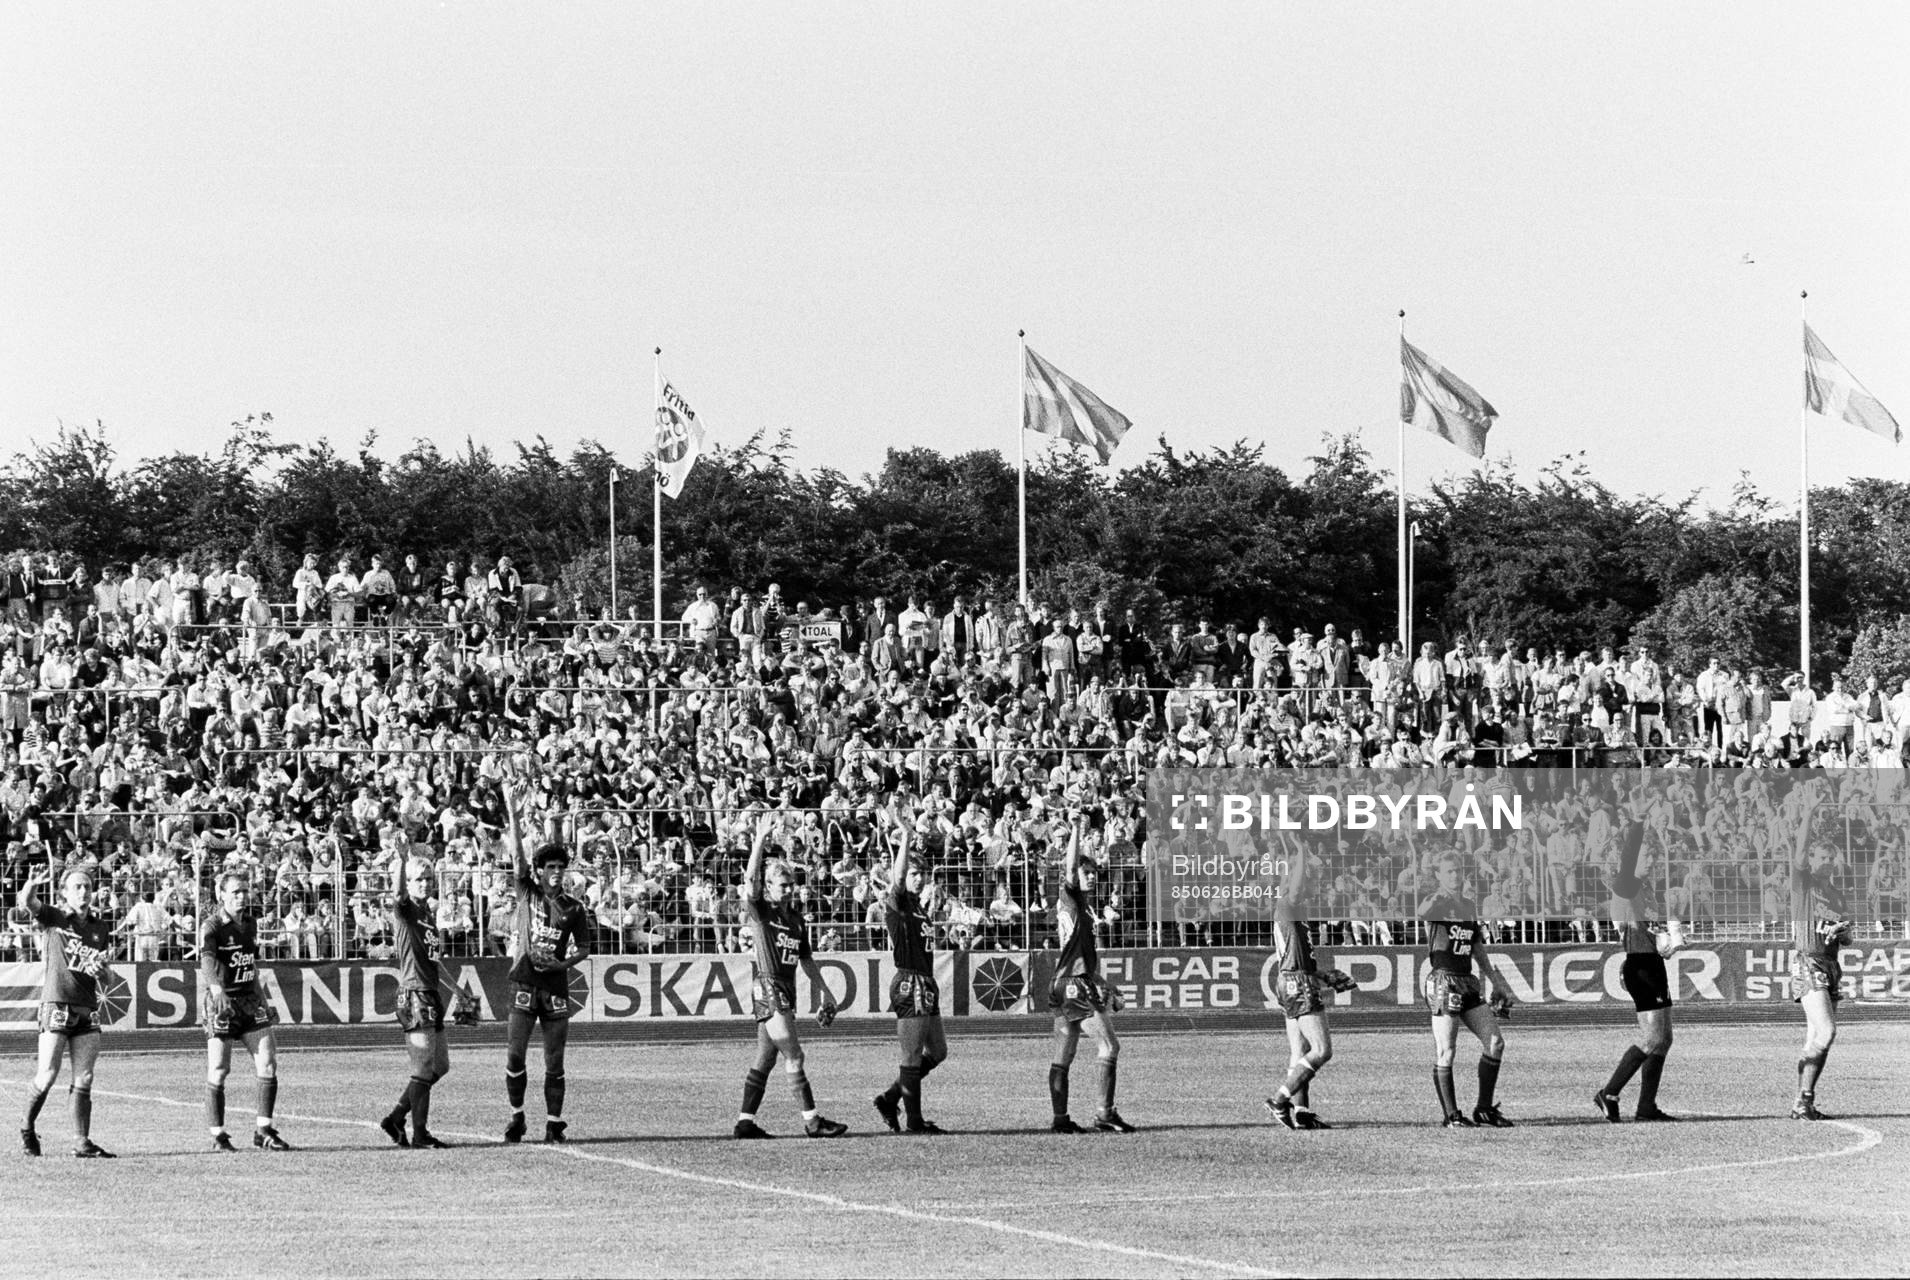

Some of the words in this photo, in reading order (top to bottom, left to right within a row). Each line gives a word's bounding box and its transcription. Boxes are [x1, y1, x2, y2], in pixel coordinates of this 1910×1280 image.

[807, 626, 832, 637] TOAL
[776, 932, 800, 950] Sten
[229, 951, 254, 967] Sten
[1152, 956, 1240, 980] CAR
[147, 964, 497, 1025] SANDA
[603, 958, 897, 1019] SKADI
